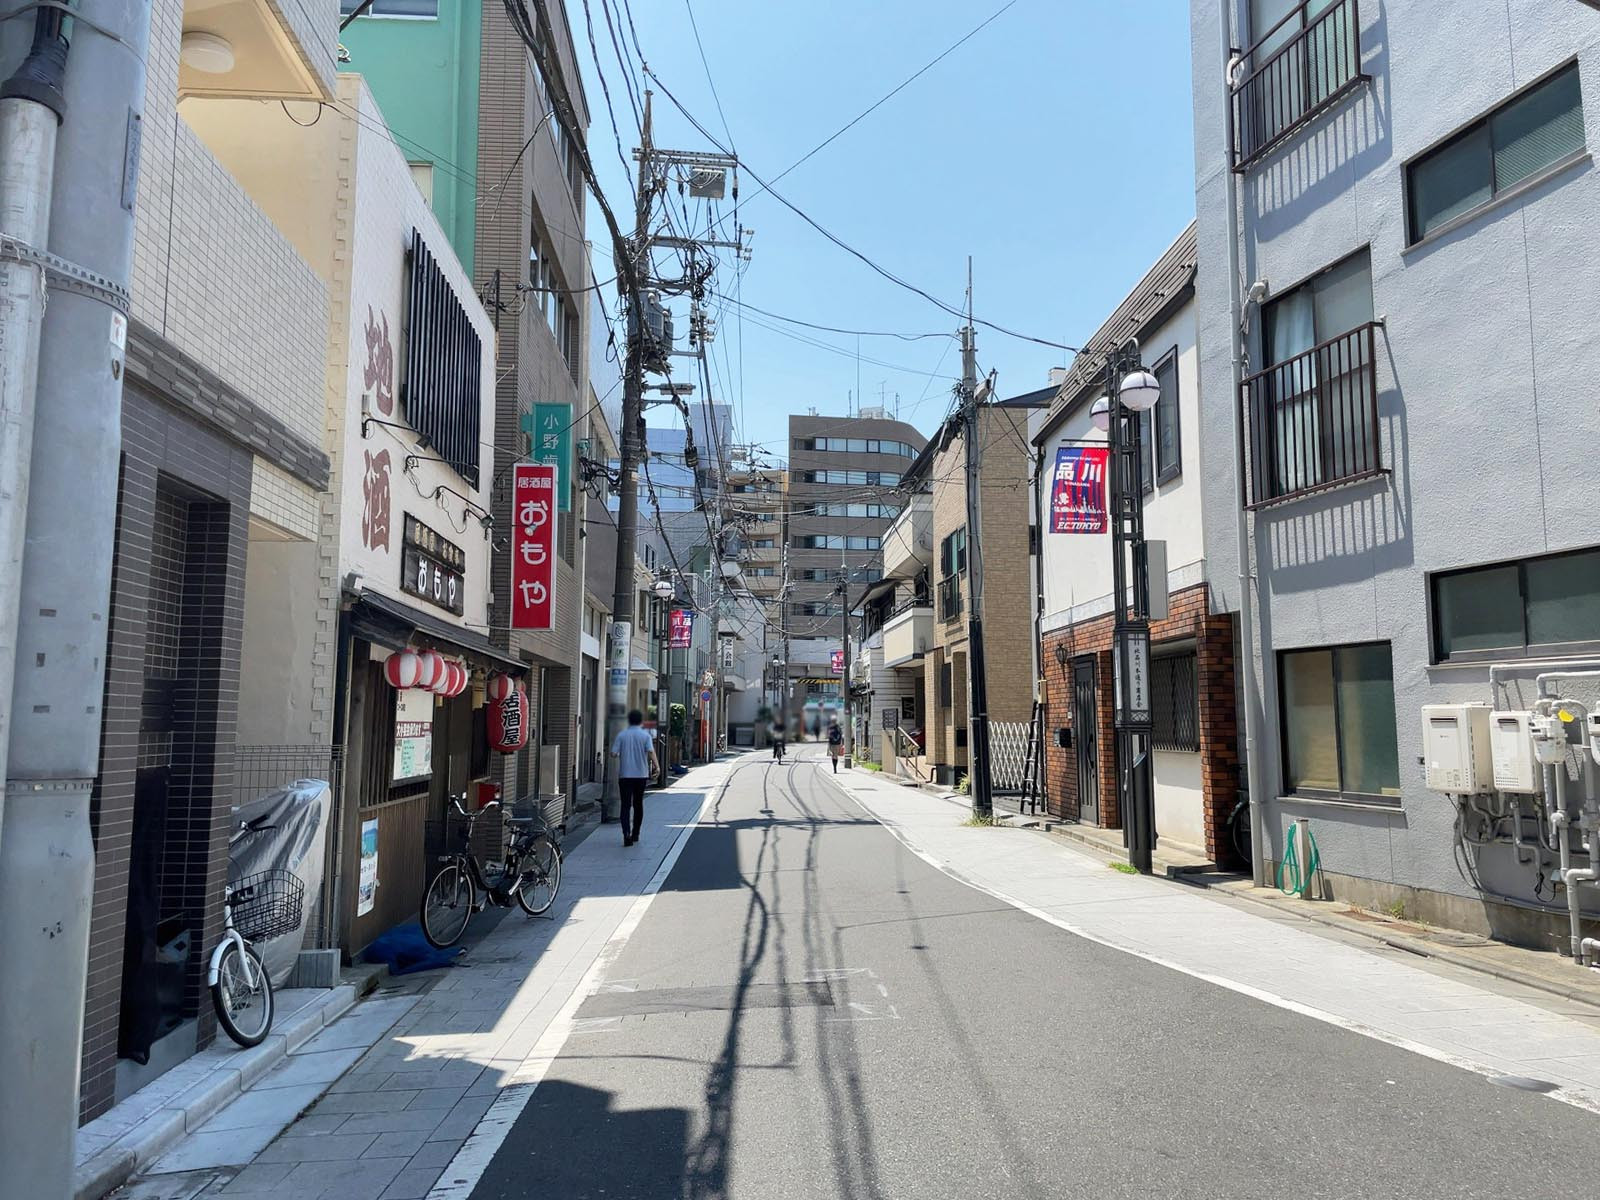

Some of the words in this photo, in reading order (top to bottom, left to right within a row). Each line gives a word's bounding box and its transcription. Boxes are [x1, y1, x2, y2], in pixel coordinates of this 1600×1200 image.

[518, 477, 552, 489] 居酒屋
[1055, 462, 1102, 482] 品川
[518, 499, 547, 609] おもや
[417, 555, 456, 607] おもや
